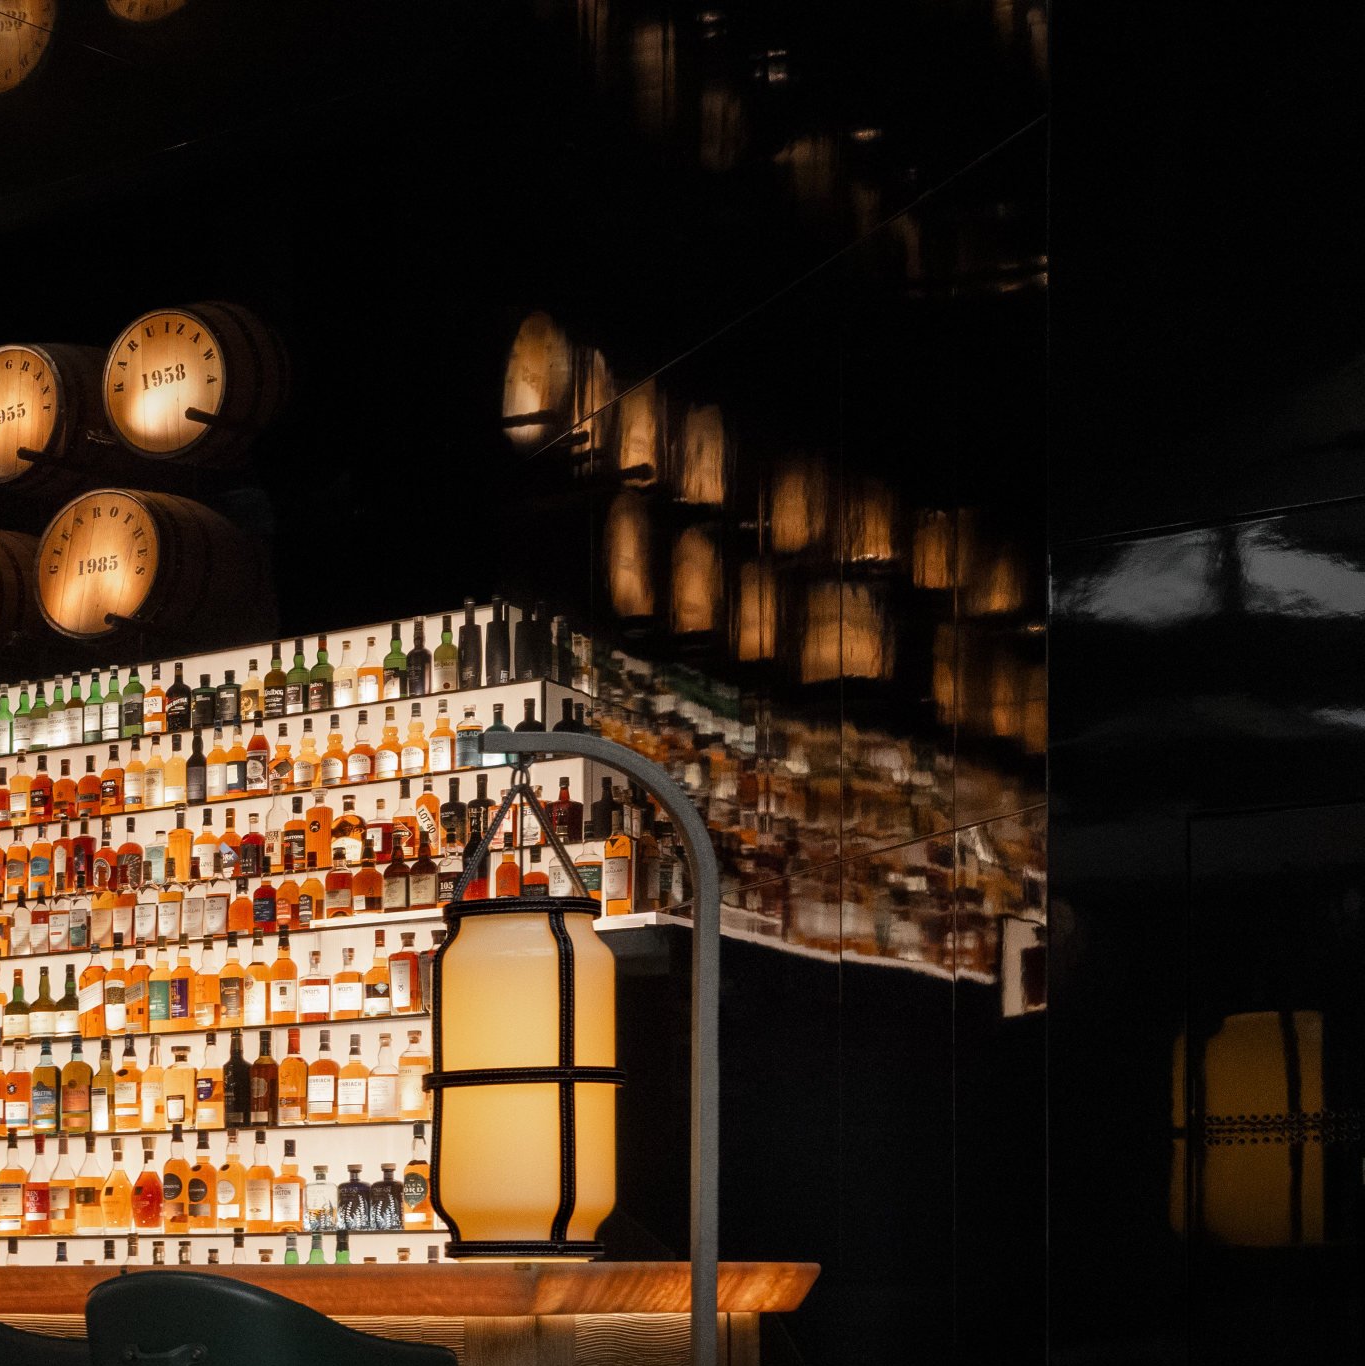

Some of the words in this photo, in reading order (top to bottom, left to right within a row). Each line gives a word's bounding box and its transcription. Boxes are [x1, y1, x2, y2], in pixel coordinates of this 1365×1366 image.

[113, 321, 218, 394] KARUIZAWA
[5, 359, 51, 412] GRANT
[142, 363, 186, 391] 1958
[48, 506, 148, 576] GLENROTHES
[78, 555, 119, 576] 1985
[418, 808, 428, 823] LOT
[425, 821, 436, 834] 40
[440, 881, 453, 890] 105
